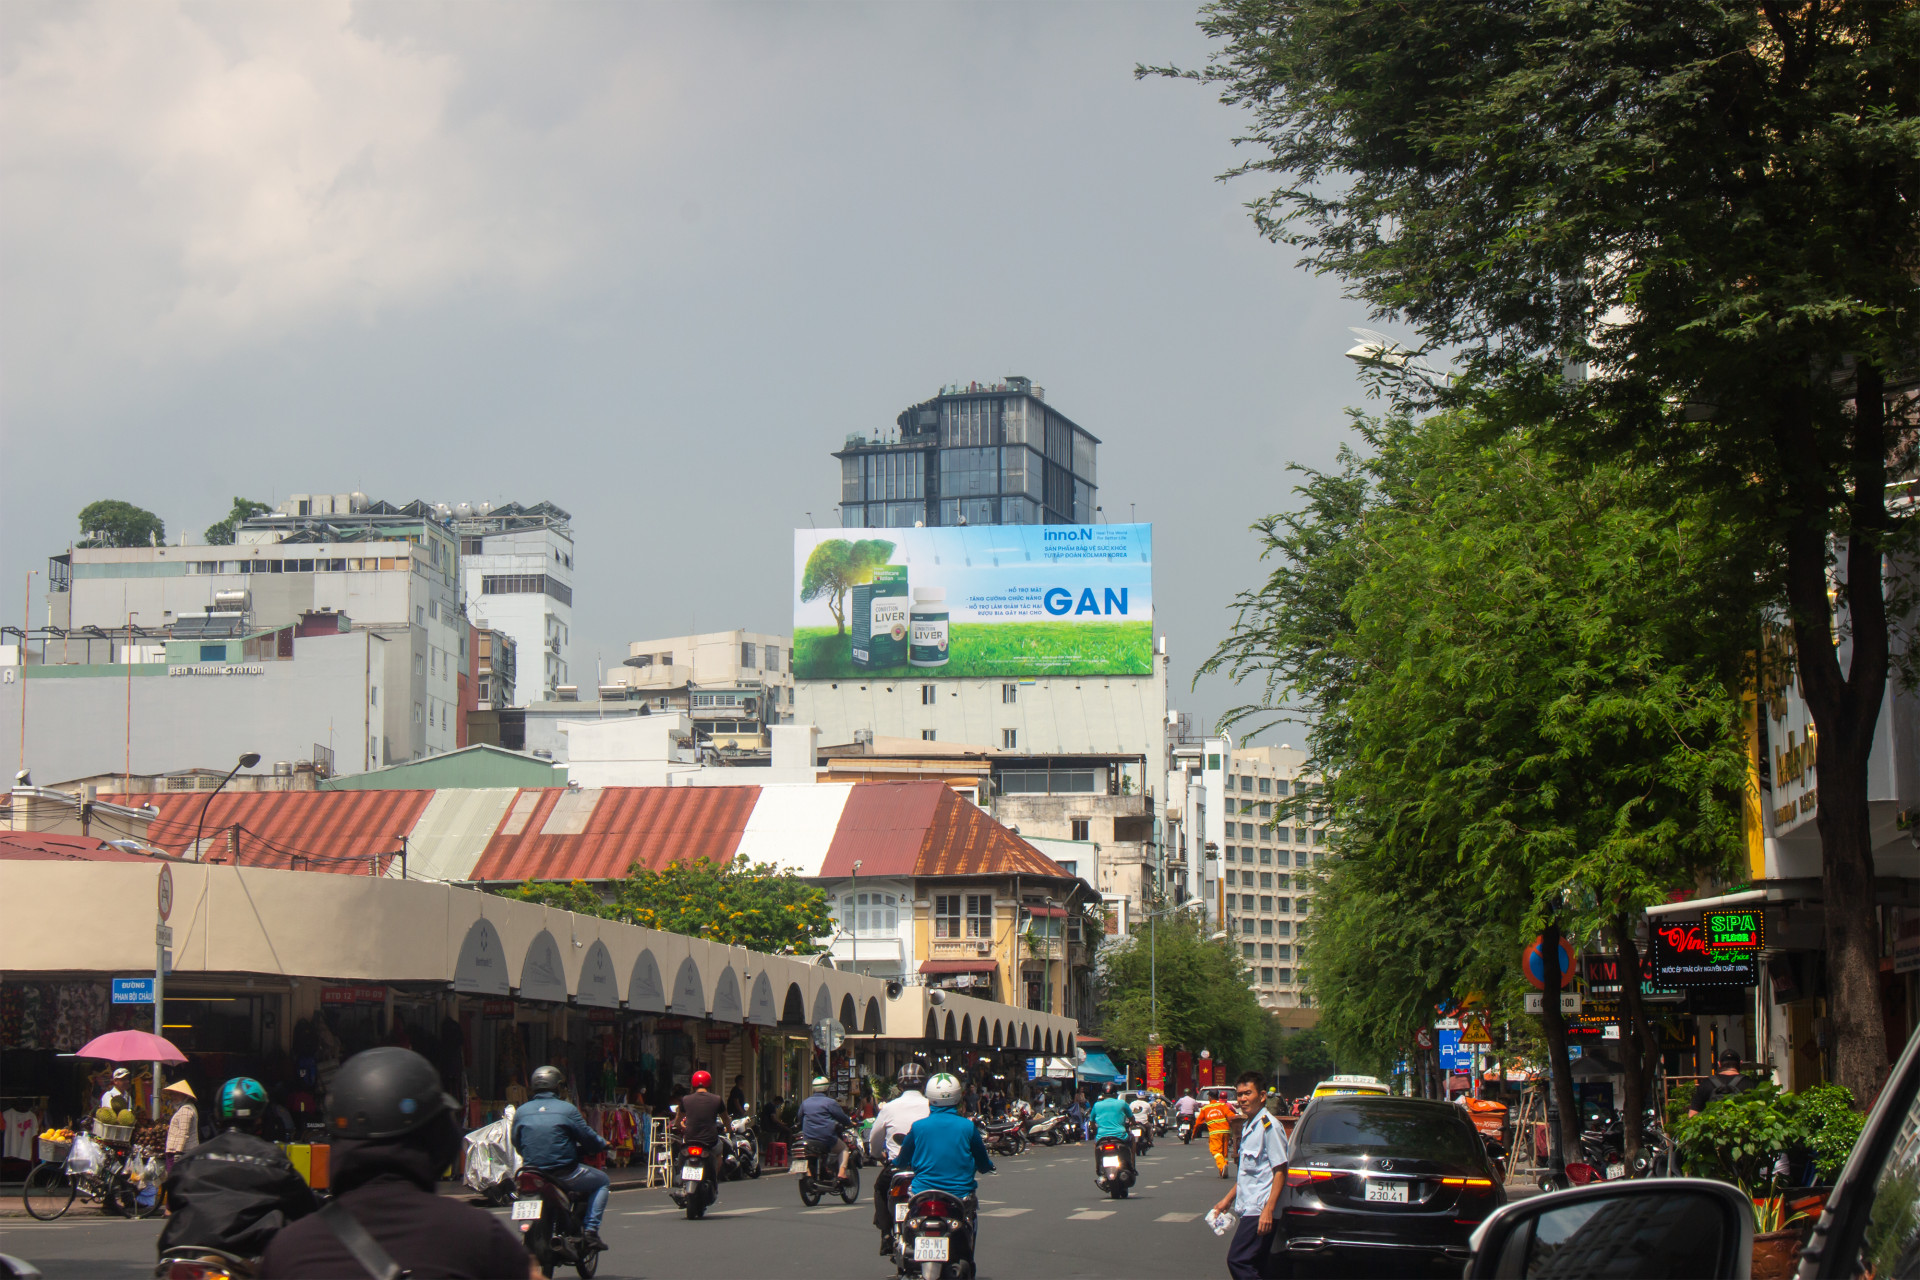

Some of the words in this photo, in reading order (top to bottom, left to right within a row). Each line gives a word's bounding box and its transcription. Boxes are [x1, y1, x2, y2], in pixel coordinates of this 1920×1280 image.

[1044, 528, 1092, 541] inno.N
[1044, 587, 1128, 615] GAN
[876, 612, 905, 622] LIVER
[170, 667, 188, 676] BEN
[192, 666, 222, 676] THANH
[225, 665, 264, 674] STATION
[1711, 915, 1756, 932] SPA
[1721, 934, 1749, 942] FLOOR
[1590, 962, 1616, 980] KIM
[128, 993, 138, 1001] BỘI
[138, 991, 152, 1000] CHÂU
[1378, 1182, 1395, 1191] 51K
[1370, 1192, 1403, 1201] 230.41
[916, 1250, 946, 1259] 700.25
